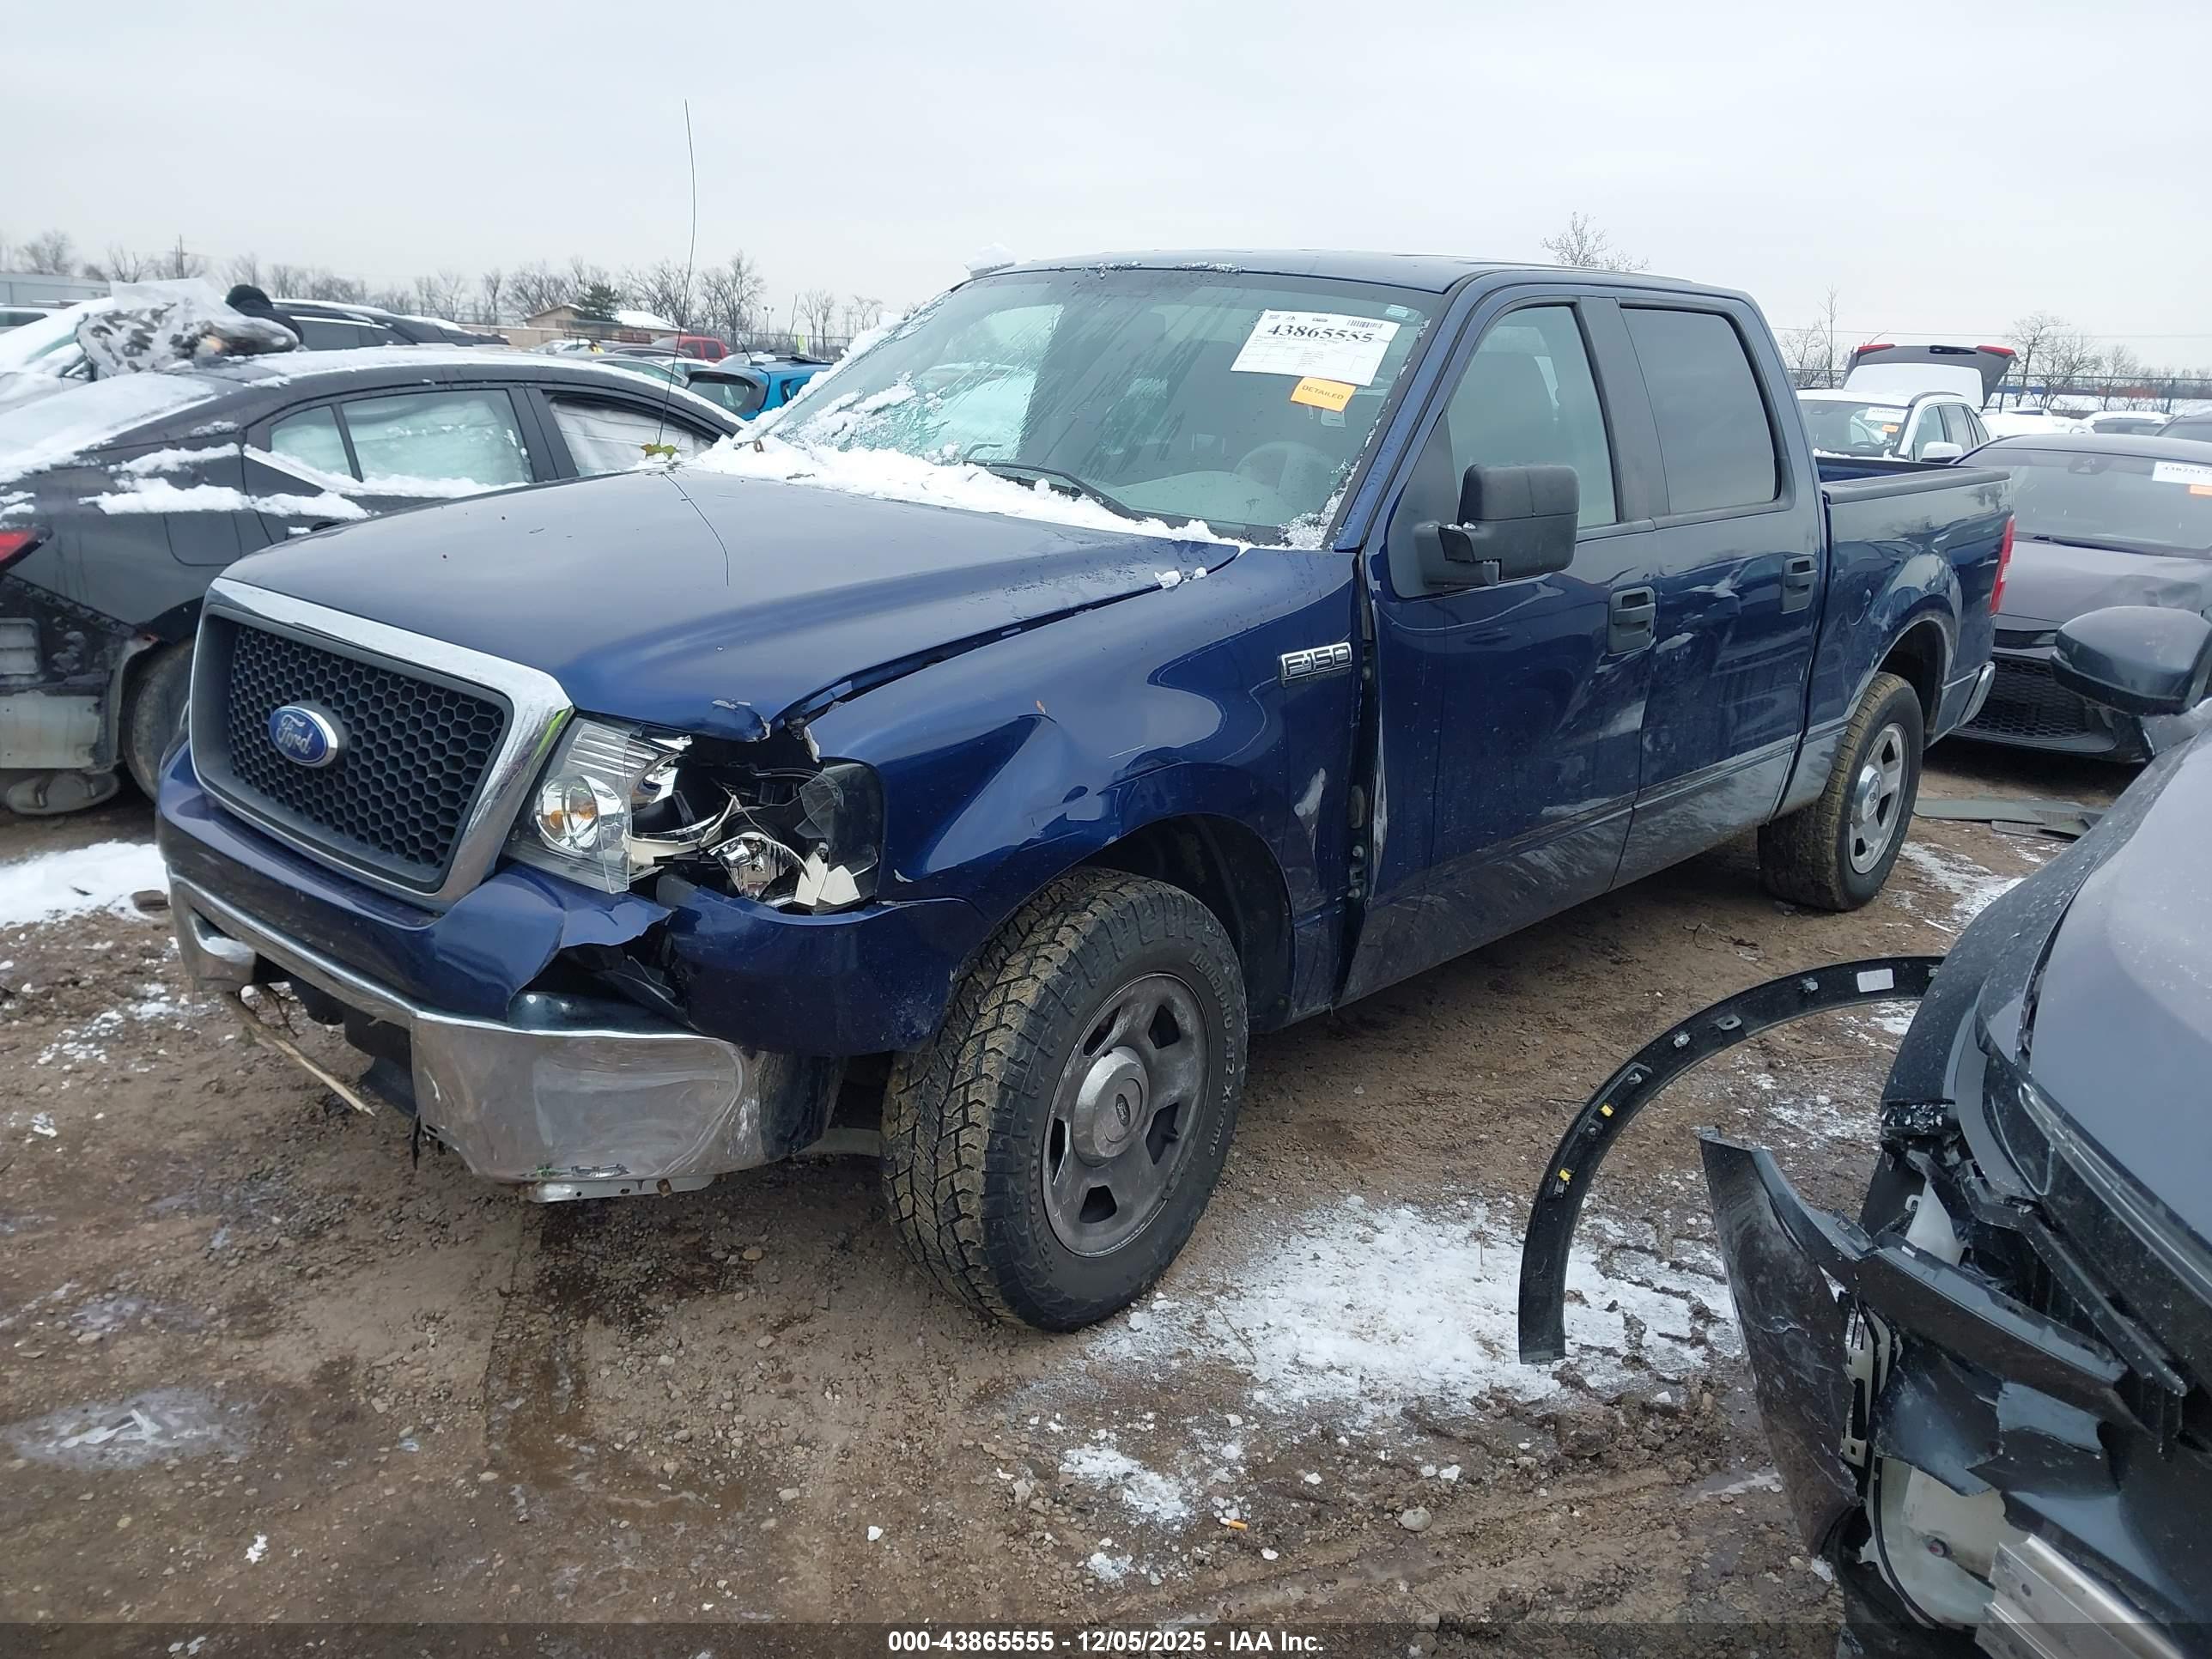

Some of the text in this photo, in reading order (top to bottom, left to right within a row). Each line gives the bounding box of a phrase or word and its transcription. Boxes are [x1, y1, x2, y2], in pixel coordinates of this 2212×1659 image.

[1267, 323, 1375, 343] 43865555
[1301, 385, 1345, 400] DETAILED
[276, 714, 313, 755] Ford
